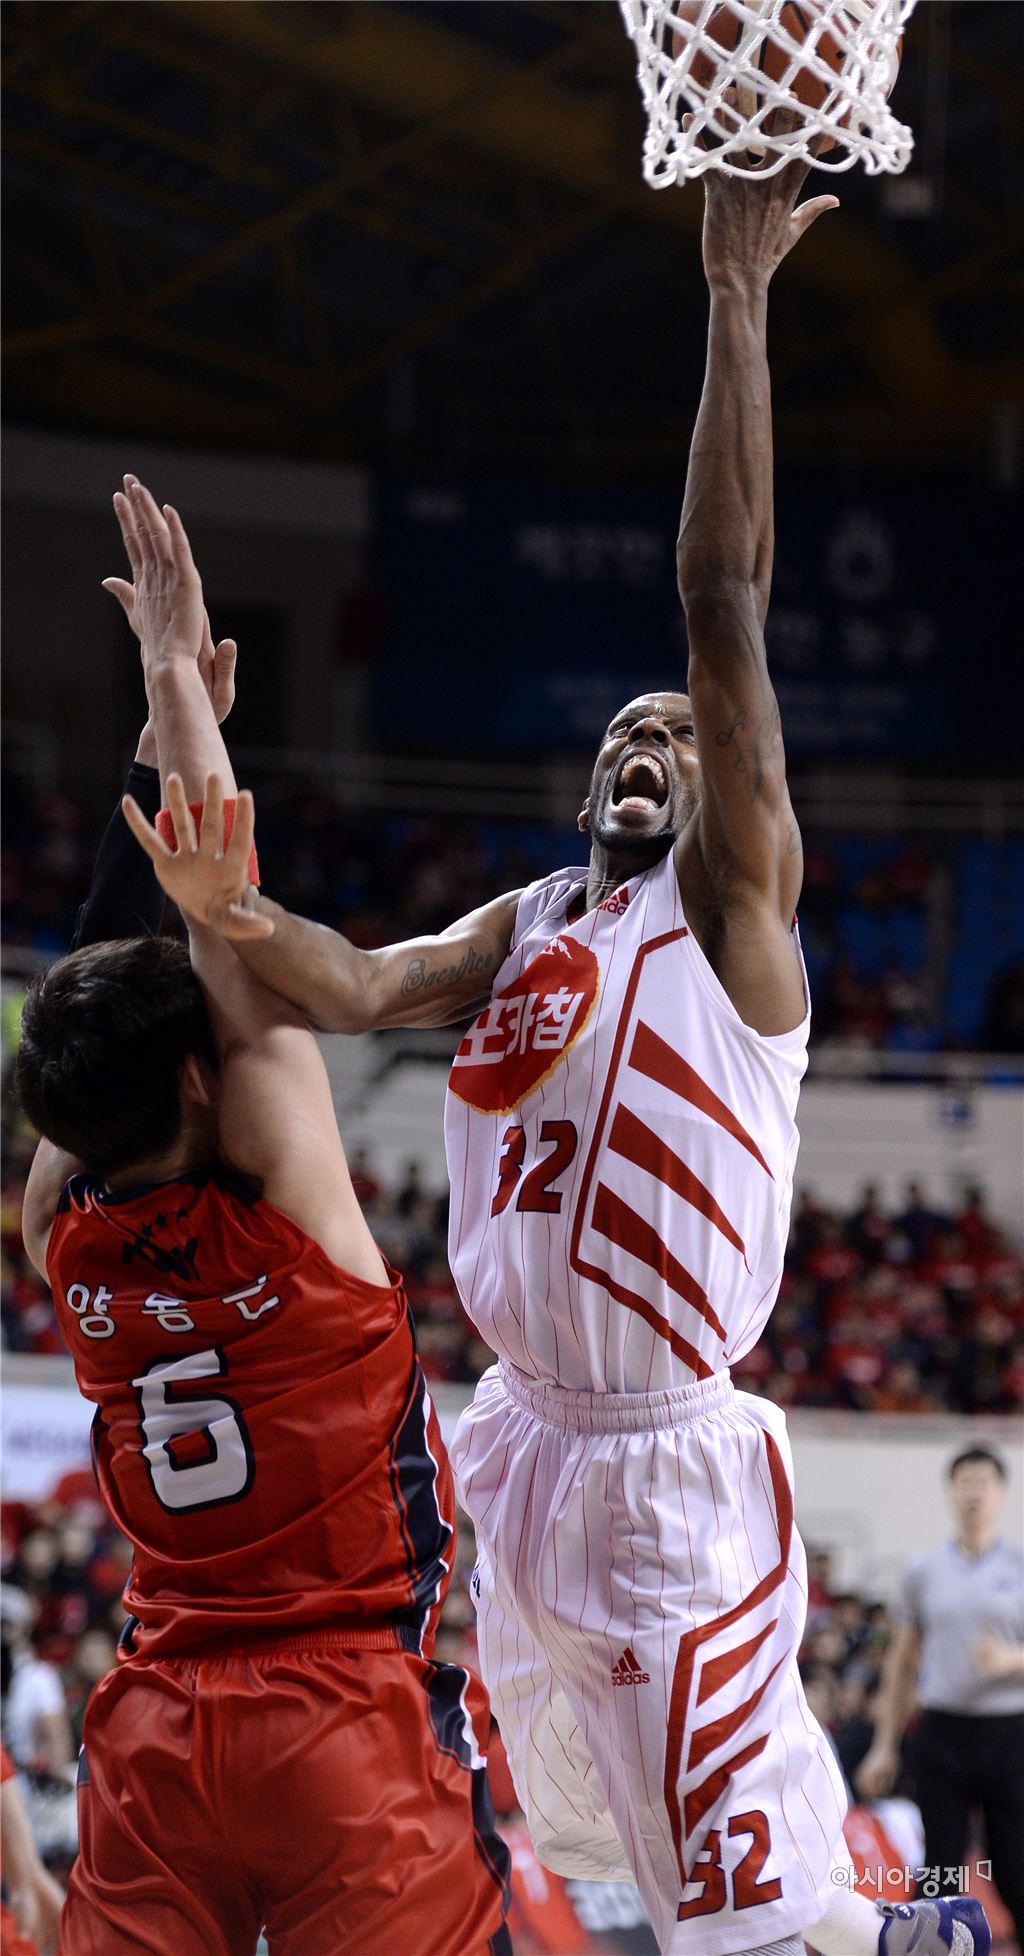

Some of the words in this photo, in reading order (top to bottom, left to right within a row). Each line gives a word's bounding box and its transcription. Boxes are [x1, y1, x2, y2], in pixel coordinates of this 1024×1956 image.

[452, 986, 585, 1067] 포카칩
[491, 1120, 578, 1219] 32
[131, 1348, 255, 1515] 6
[677, 1809, 784, 1922] 32
